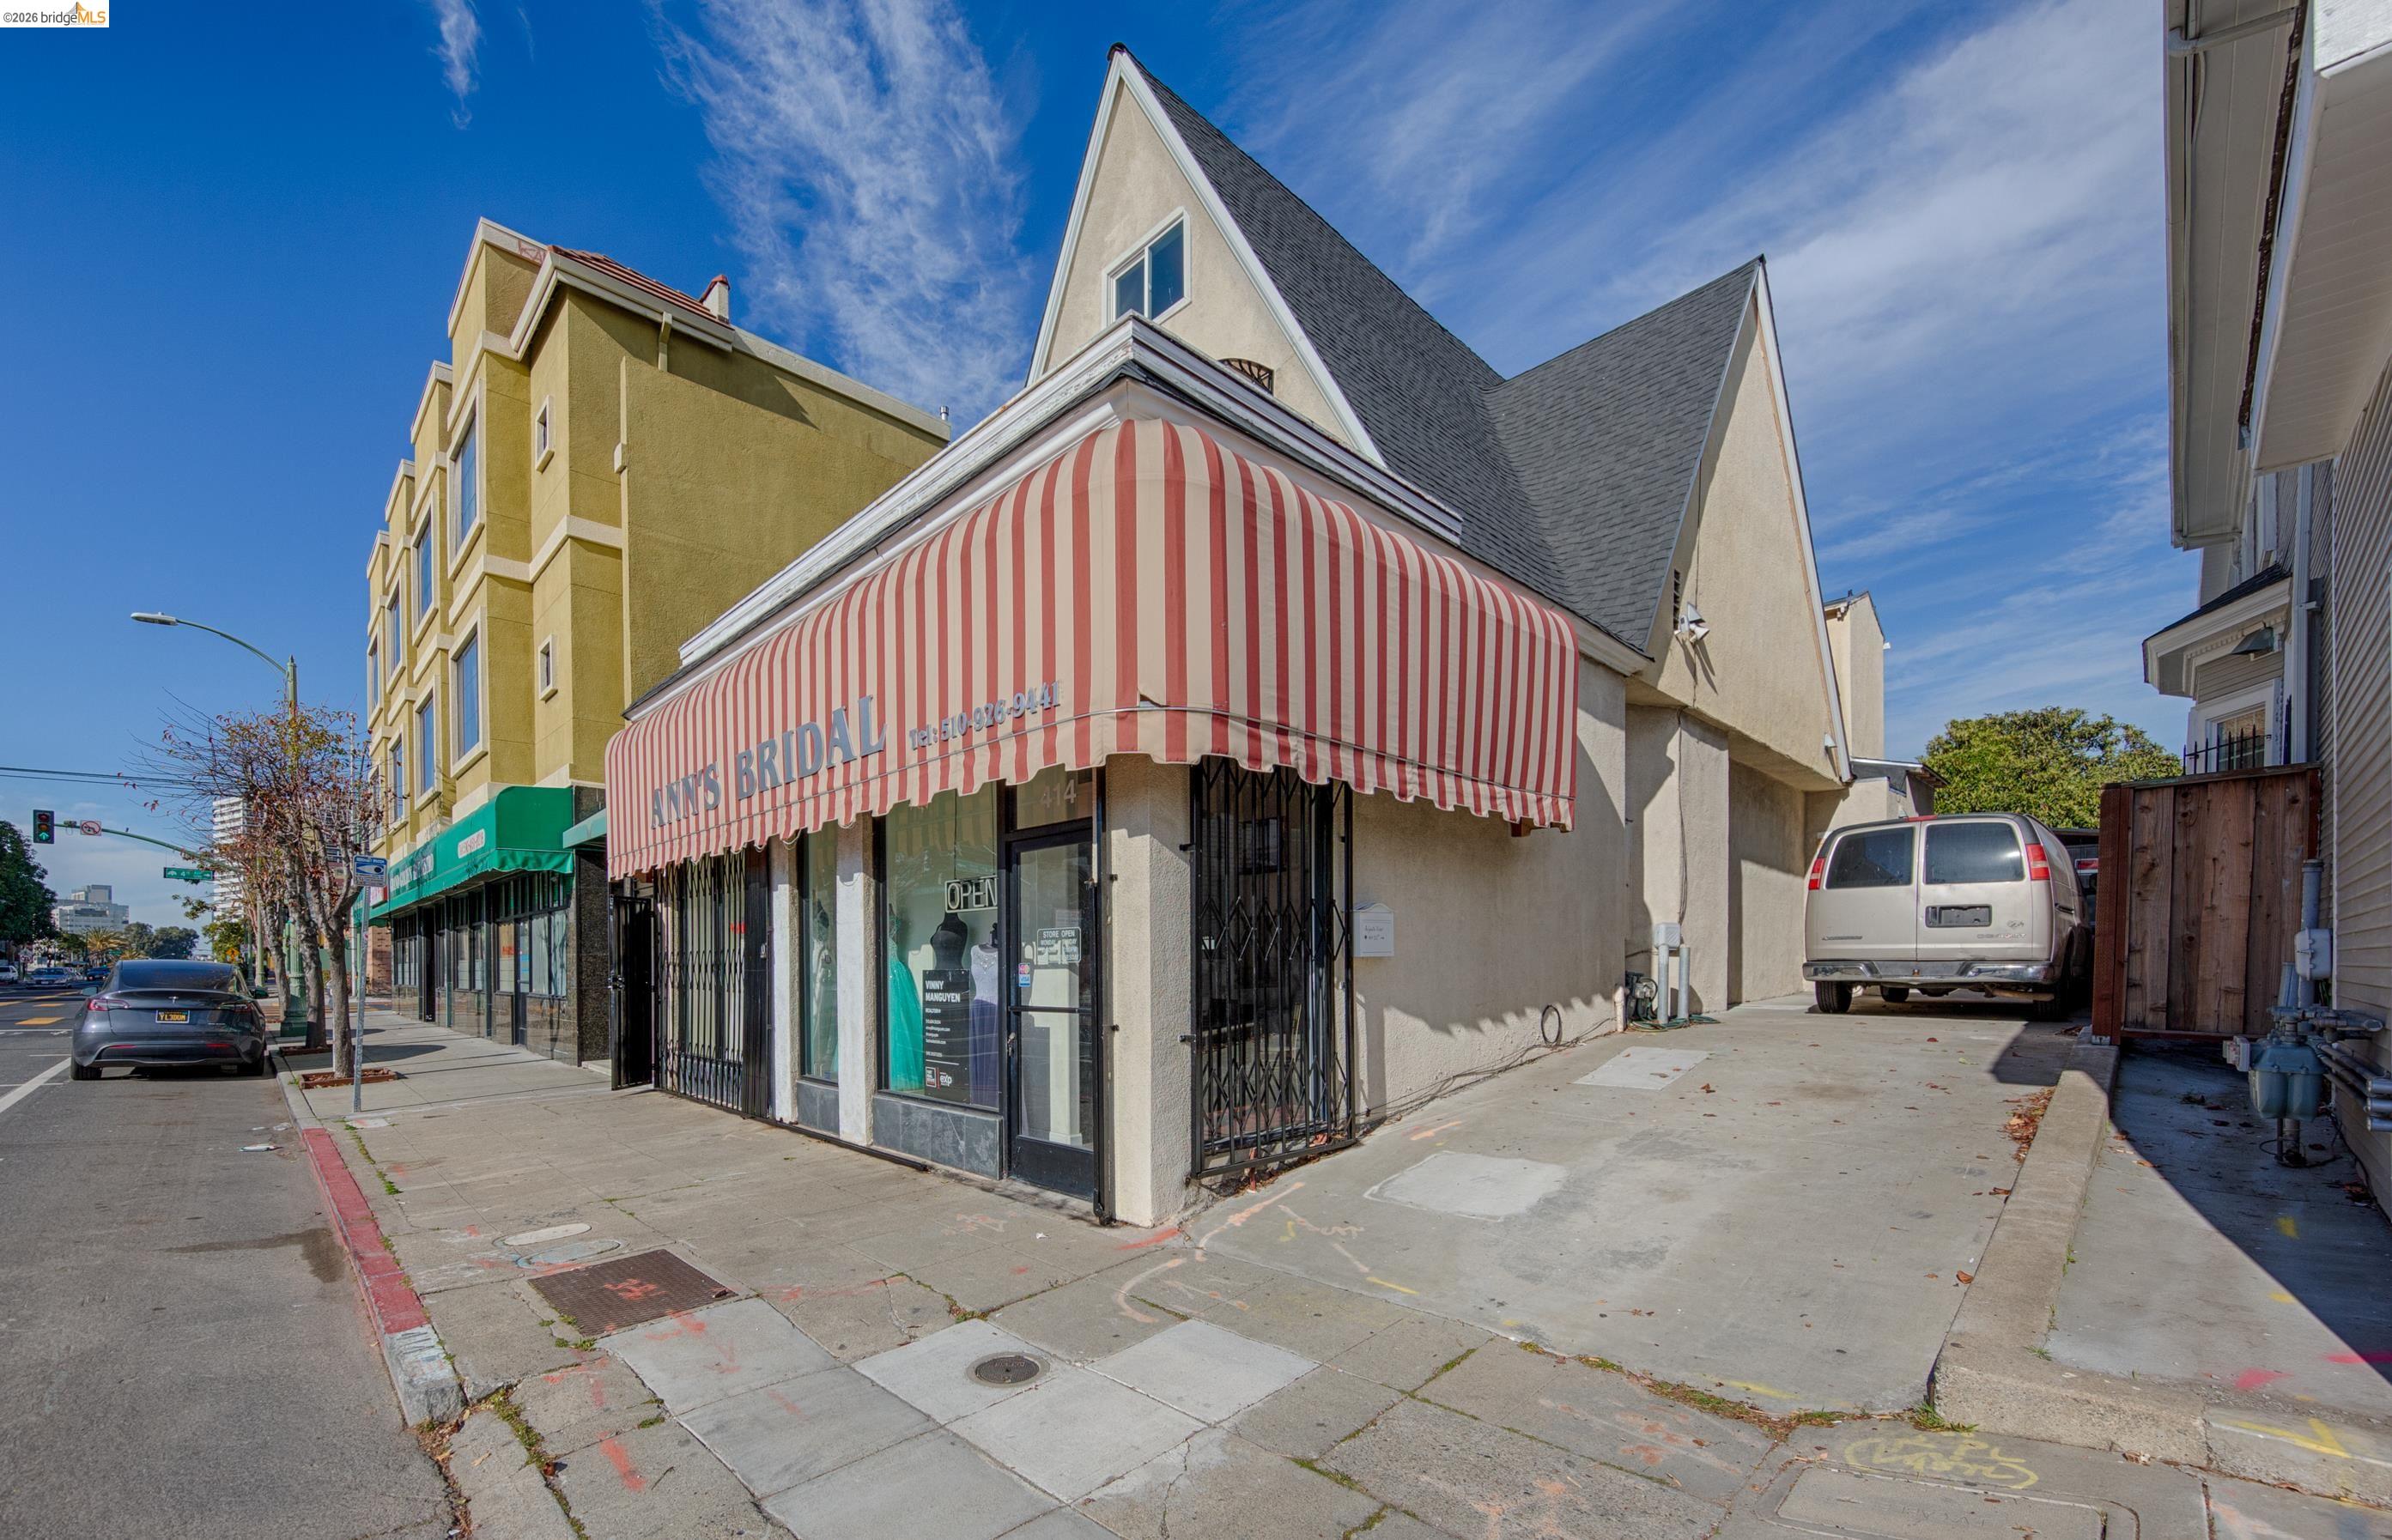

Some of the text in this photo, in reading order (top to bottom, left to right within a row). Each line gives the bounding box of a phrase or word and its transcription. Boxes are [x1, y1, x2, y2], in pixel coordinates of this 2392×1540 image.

[909, 725, 938, 751] Tel:
[651, 694, 888, 830] ANN'S BRIDAL
[1040, 779, 1077, 809] 414
[948, 877, 997, 909] OPEN
[925, 979, 944, 990] VINNY
[925, 991, 961, 1003] MANGUYEN
